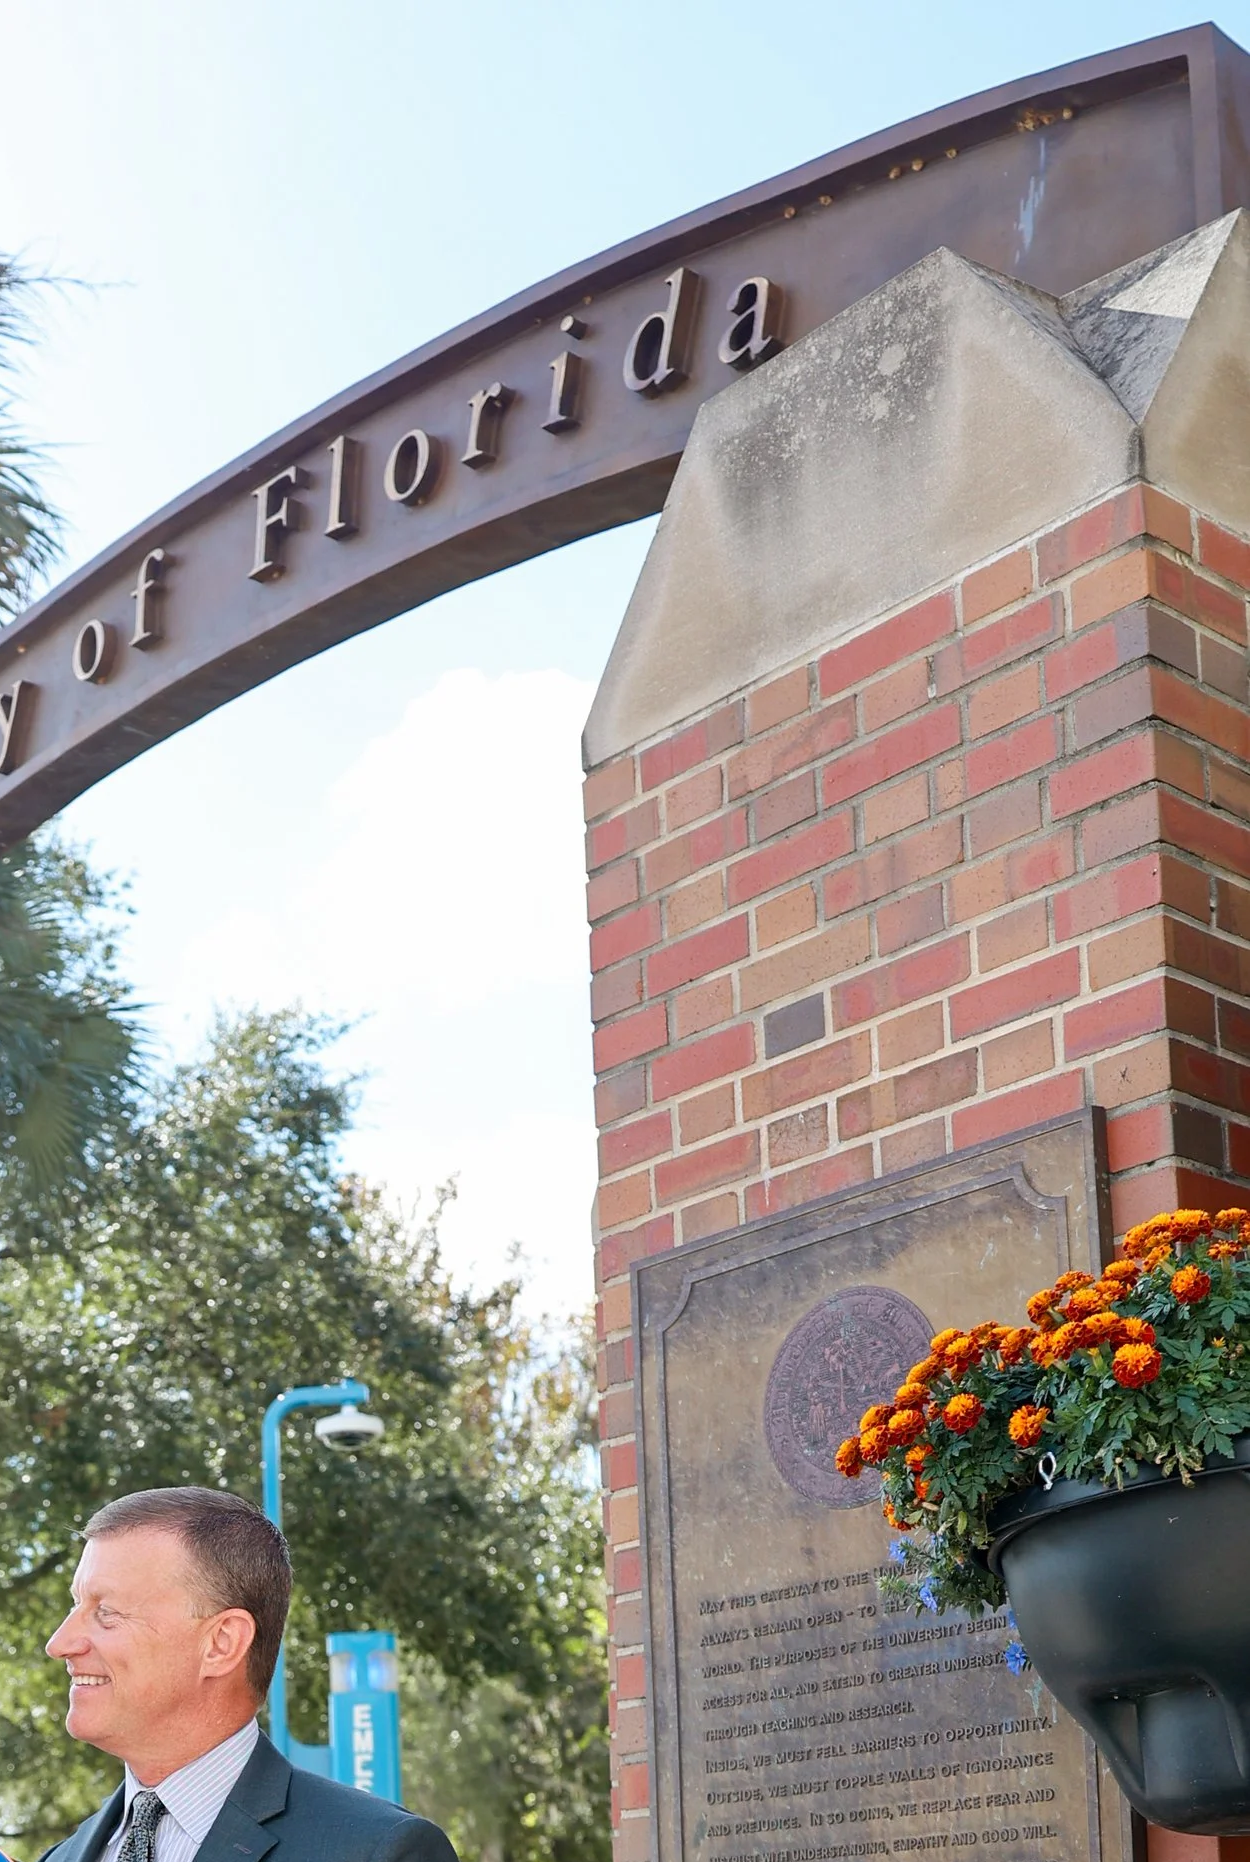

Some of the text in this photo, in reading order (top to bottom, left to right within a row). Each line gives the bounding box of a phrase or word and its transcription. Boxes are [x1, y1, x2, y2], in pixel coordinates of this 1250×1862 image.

[71, 546, 176, 686] of
[247, 265, 787, 584] Florida
[700, 1601, 724, 1615] MAY
[729, 1594, 756, 1609] THIS
[760, 1582, 818, 1604] GATEWAY
[821, 1577, 838, 1592] TO
[843, 1572, 868, 1588] THE
[700, 1629, 749, 1647] ALWAYS
[753, 1618, 802, 1637] REMAIN
[807, 1610, 842, 1627] OPEN
[858, 1604, 876, 1618] TO
[702, 1615, 1007, 1678] WORLD. THE PURPOSES OF THE UNIVERSITY BEGIN
[702, 1652, 1008, 1710] ACCESS FOR ALL, AND EXTEND TO GREATER UNDERSTA
[704, 1701, 915, 1742] THROUGH TEACHING AND RESEARCH.
[706, 1716, 1052, 1774] INSIDE, WE MUST FELL BARRIERS TO OPPORTUNITY.
[707, 1752, 1055, 1806] OUTSIDE, WE MUST TOPPLE WALLS OF IGNORANCE
[707, 1788, 1055, 1837] AND PREJUDICE. IN SO DOING, WE REPLACE FEAR AND
[792, 1841, 890, 1862] UNDERSTANDING,
[893, 1835, 948, 1852] EMPATHY
[951, 1832, 977, 1846] AND
[982, 1828, 1019, 1844] GOOD
[1022, 1825, 1057, 1840] WILL.
